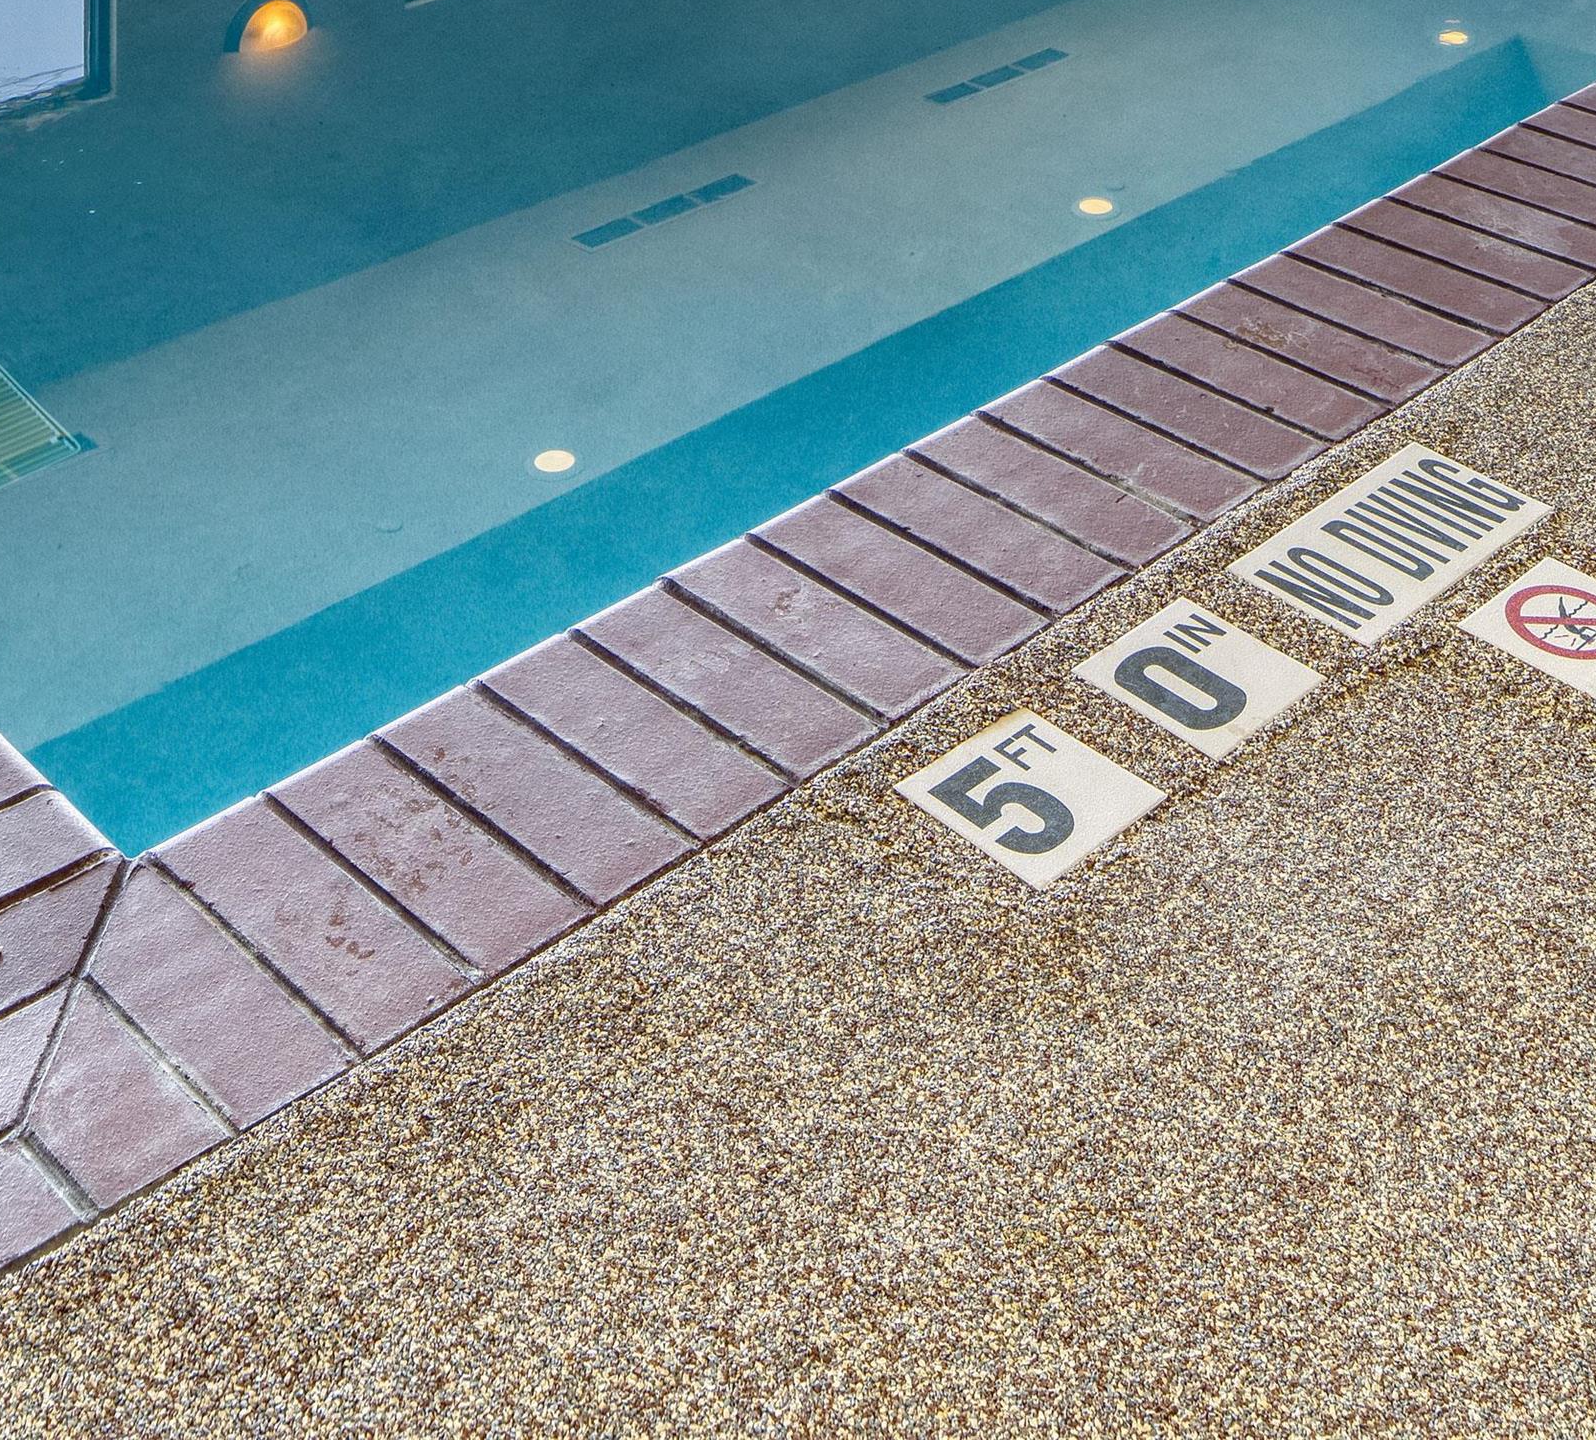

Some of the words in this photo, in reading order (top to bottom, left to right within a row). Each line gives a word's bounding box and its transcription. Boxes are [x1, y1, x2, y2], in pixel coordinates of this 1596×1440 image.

[1320, 458, 1527, 582] DIVING
[1254, 546, 1395, 631] NO
[1164, 612, 1227, 657] IN
[1112, 646, 1248, 731] 0
[993, 723, 1059, 773] FT
[928, 756, 1075, 855] 5
